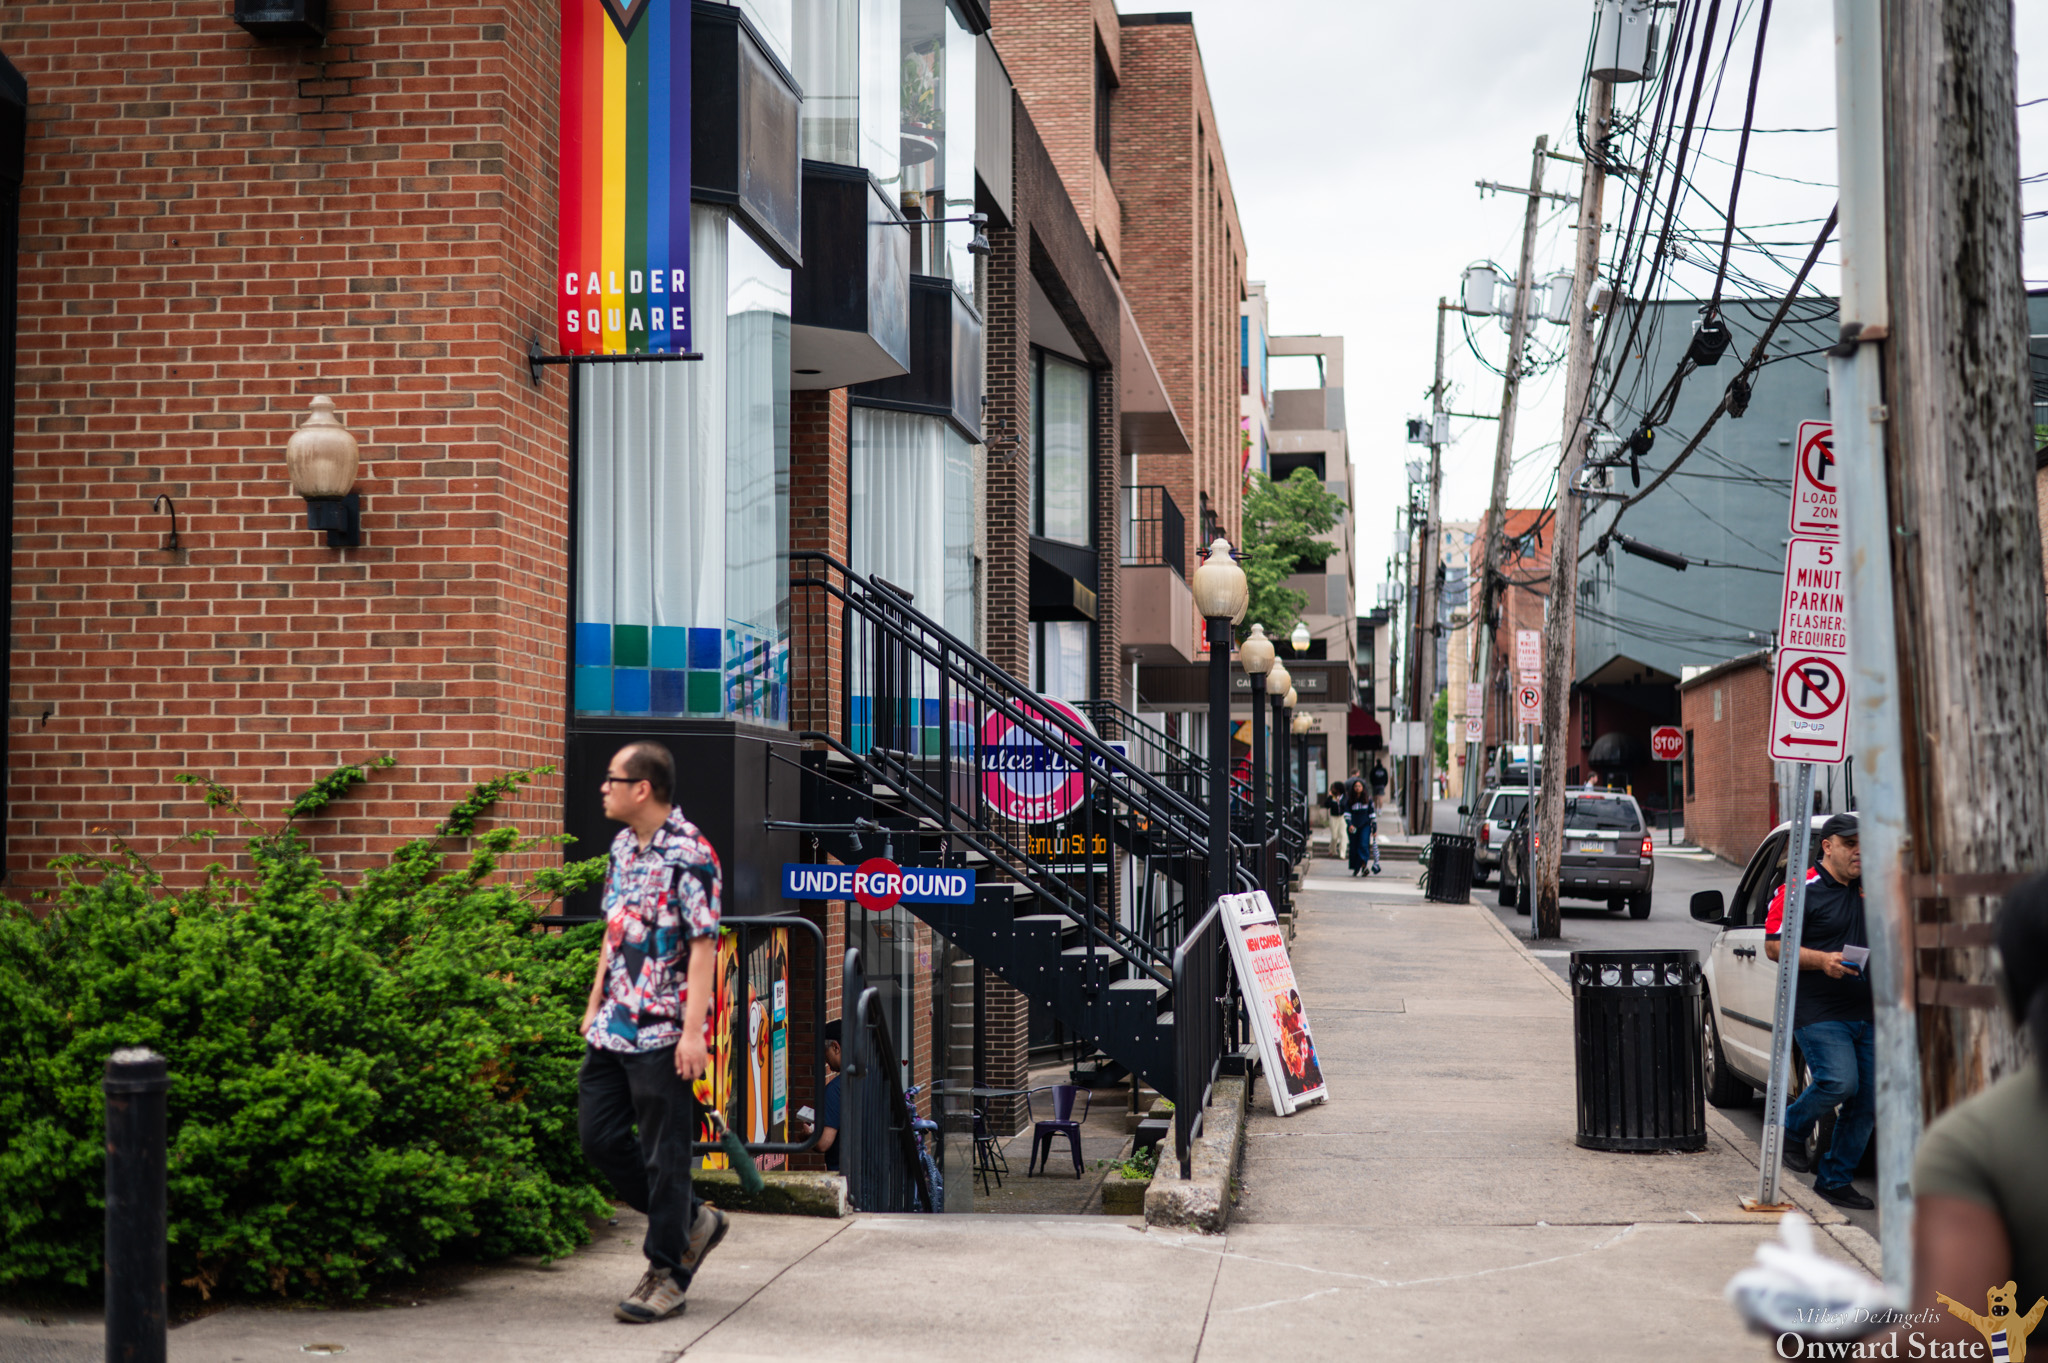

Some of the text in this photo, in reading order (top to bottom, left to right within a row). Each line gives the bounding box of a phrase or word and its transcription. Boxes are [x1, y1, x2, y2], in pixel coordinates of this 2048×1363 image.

[565, 269, 685, 295] CALDER
[567, 307, 685, 334] SQUARE
[1802, 492, 1838, 505] LOAD
[1812, 506, 1838, 519] ZON
[1818, 545, 1834, 565] 5
[1797, 568, 1842, 590] MINUT
[1789, 591, 1844, 613] PARKIN
[1789, 630, 1846, 648] REQUIRED
[1654, 736, 1682, 751] STOP
[982, 749, 1033, 771] ulce
[1010, 797, 1058, 817] CAFÉ
[790, 870, 967, 897] UNDERGROUND
[1245, 934, 1282, 952] NEW COMBO
[1252, 951, 1290, 975] CHICKEN
